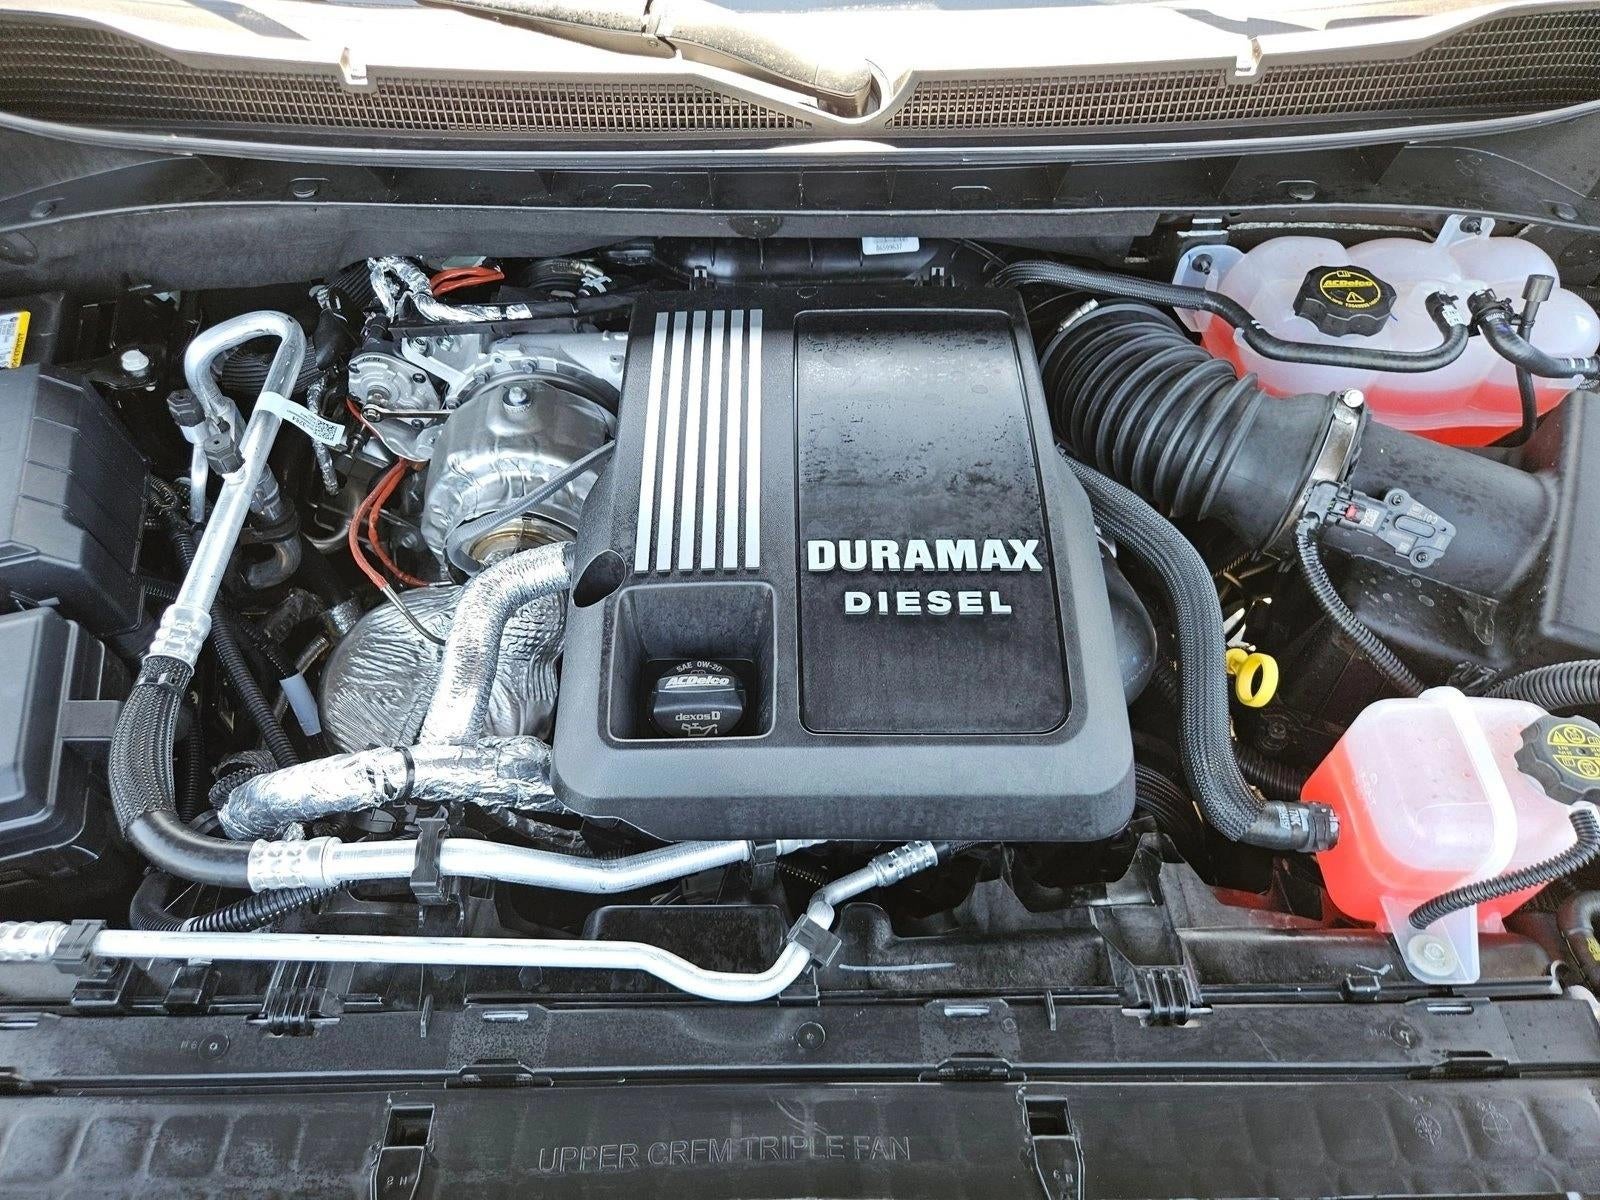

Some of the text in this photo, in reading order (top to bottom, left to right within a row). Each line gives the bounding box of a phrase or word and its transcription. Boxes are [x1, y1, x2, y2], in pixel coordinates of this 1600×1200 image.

[1322, 280, 1374, 288] ACDelco
[807, 539, 1043, 571] DURAMAX
[844, 590, 1012, 615] DIESEL
[676, 660, 723, 673] SAE 0W-20
[665, 675, 730, 689] ACDelco
[538, 1134, 911, 1173] UPPER CRFM TRIPLE FAN
